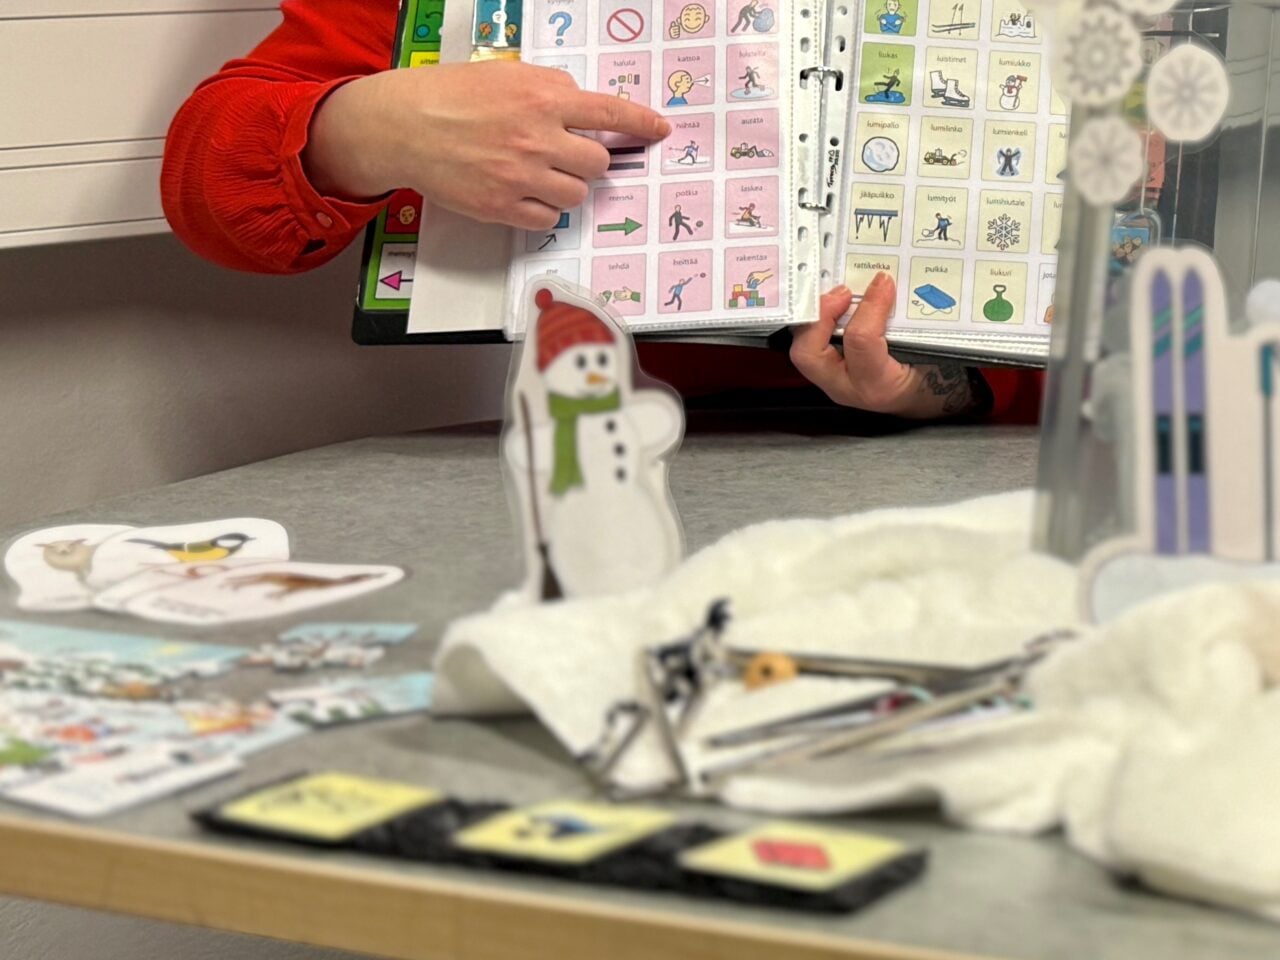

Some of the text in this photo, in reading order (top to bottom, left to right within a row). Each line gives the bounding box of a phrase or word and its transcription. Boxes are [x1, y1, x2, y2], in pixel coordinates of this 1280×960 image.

[677, 53, 701, 63] katsoa
[936, 54, 967, 64] luistimet
[998, 58, 1032, 68] lumiukko
[741, 116, 764, 125] aurata
[866, 120, 900, 131] lumipallo
[930, 123, 963, 133] lumilinko
[675, 188, 699, 199] potkia
[927, 193, 957, 203] lumityöt
[735, 253, 768, 263] rakentaa
